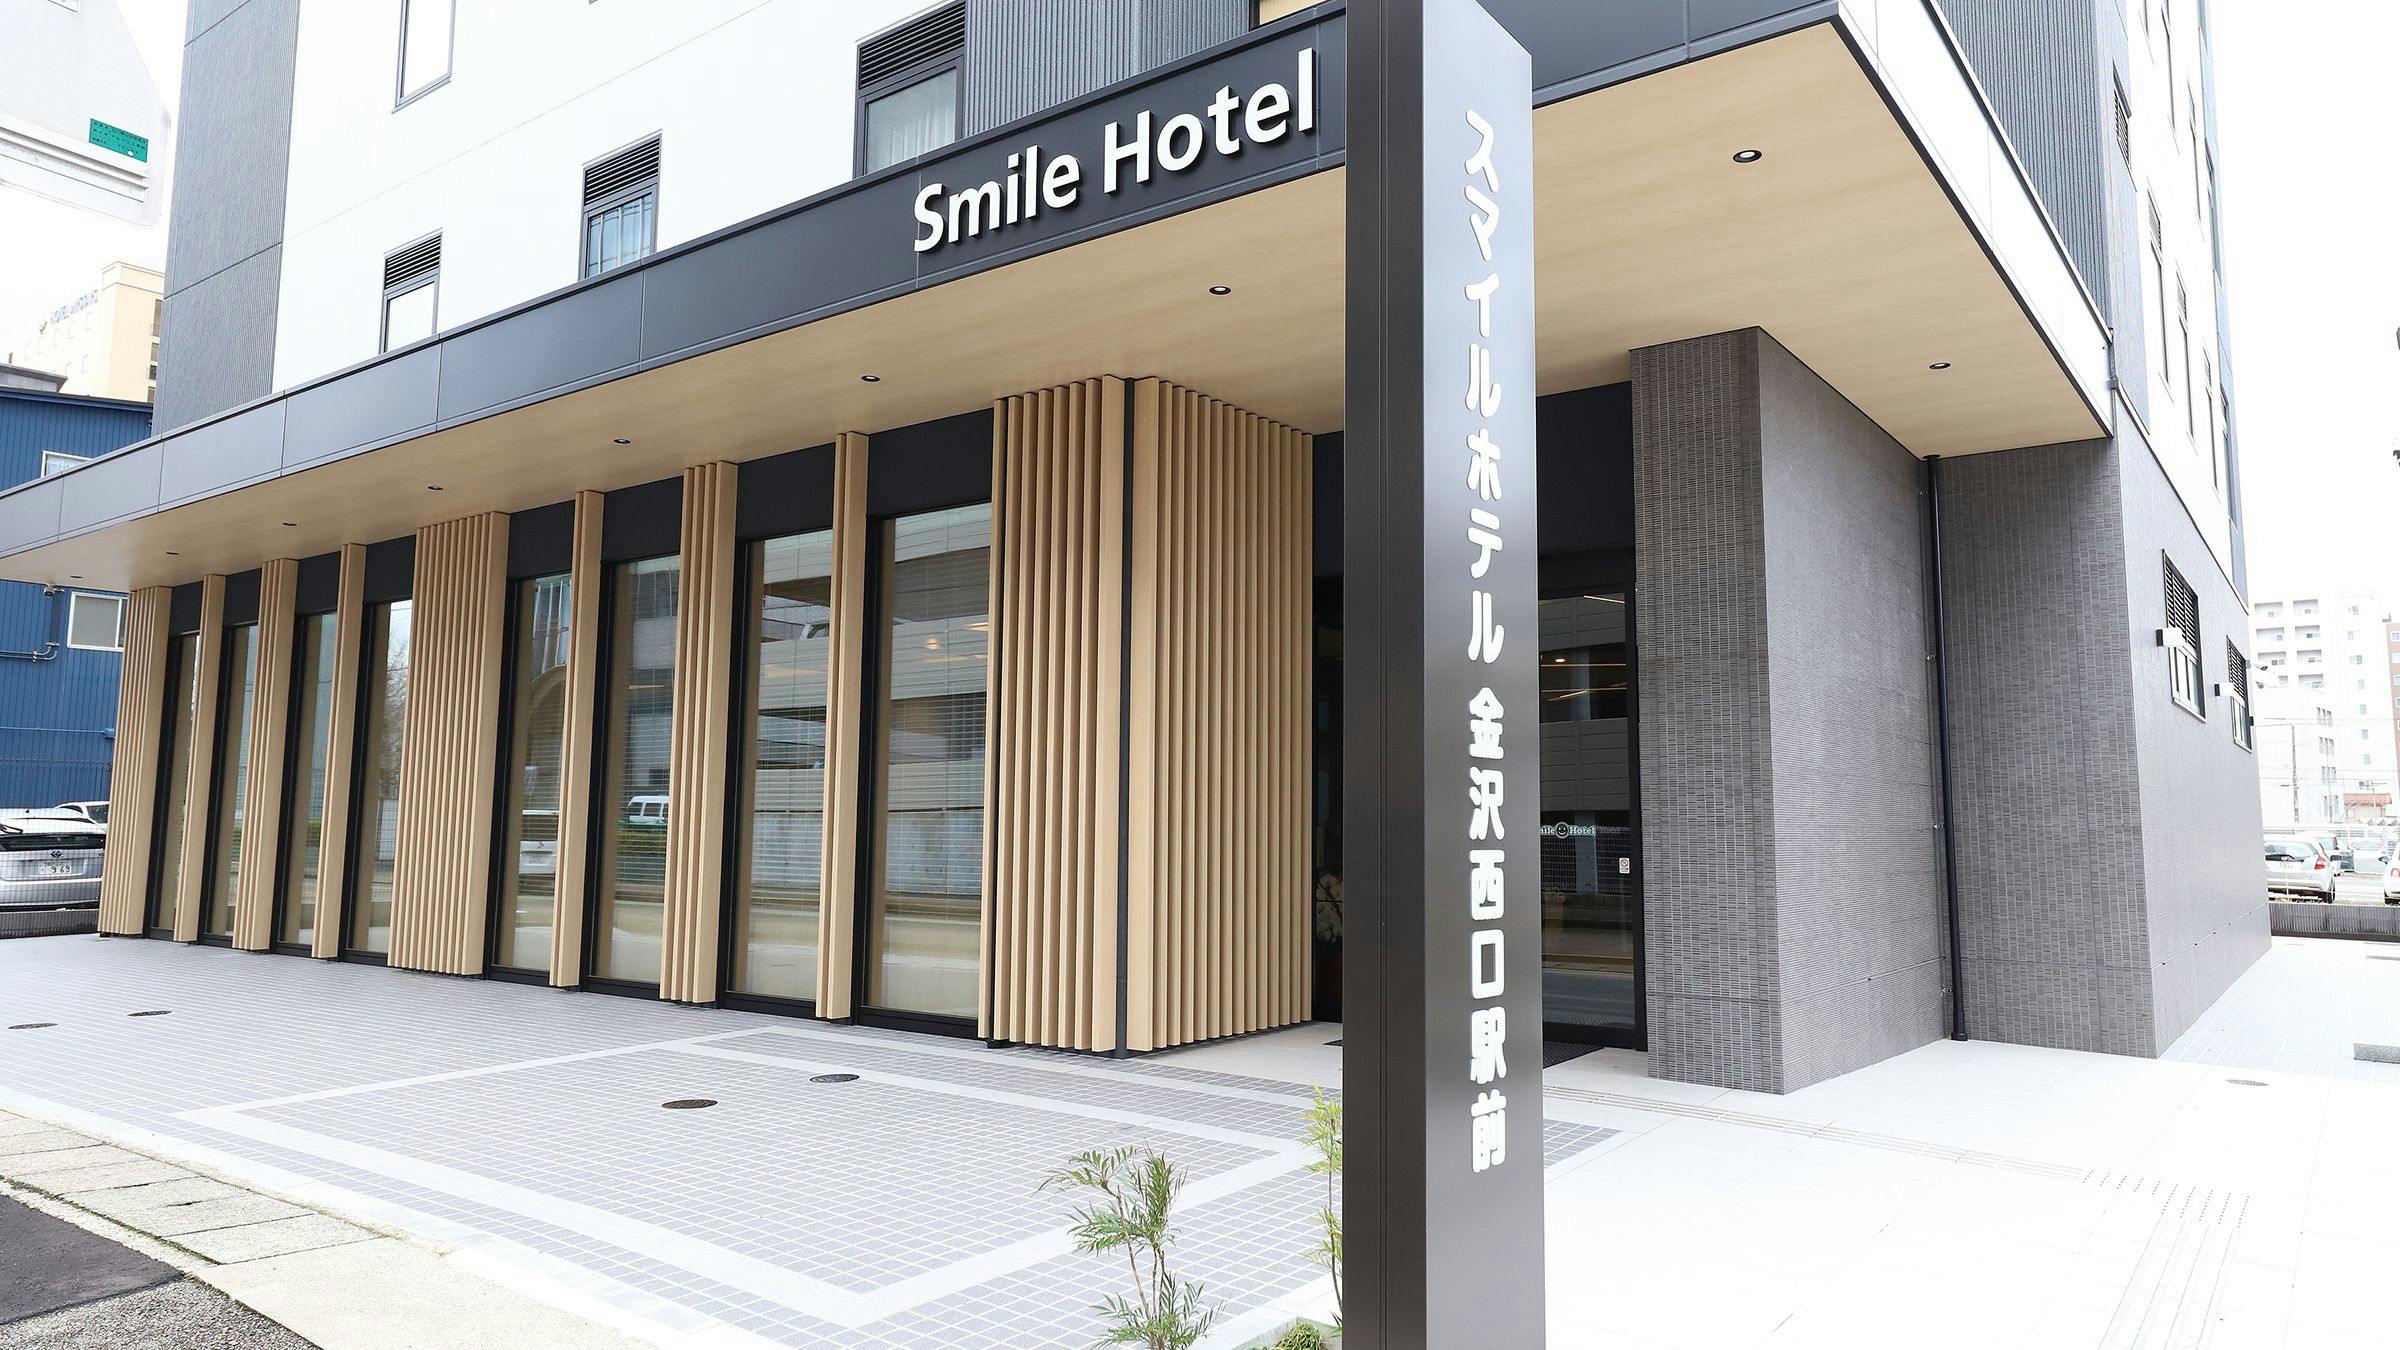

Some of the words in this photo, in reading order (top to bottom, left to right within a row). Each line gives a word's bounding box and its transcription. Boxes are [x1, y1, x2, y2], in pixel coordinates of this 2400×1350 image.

[914, 145, 1080, 252] Smile
[1104, 47, 1316, 195] Hotel
[1465, 108, 1504, 664] スマイルホテル
[1469, 687, 1507, 1173] 金沢西口駅前
[1568, 825, 1596, 837] Hotel
